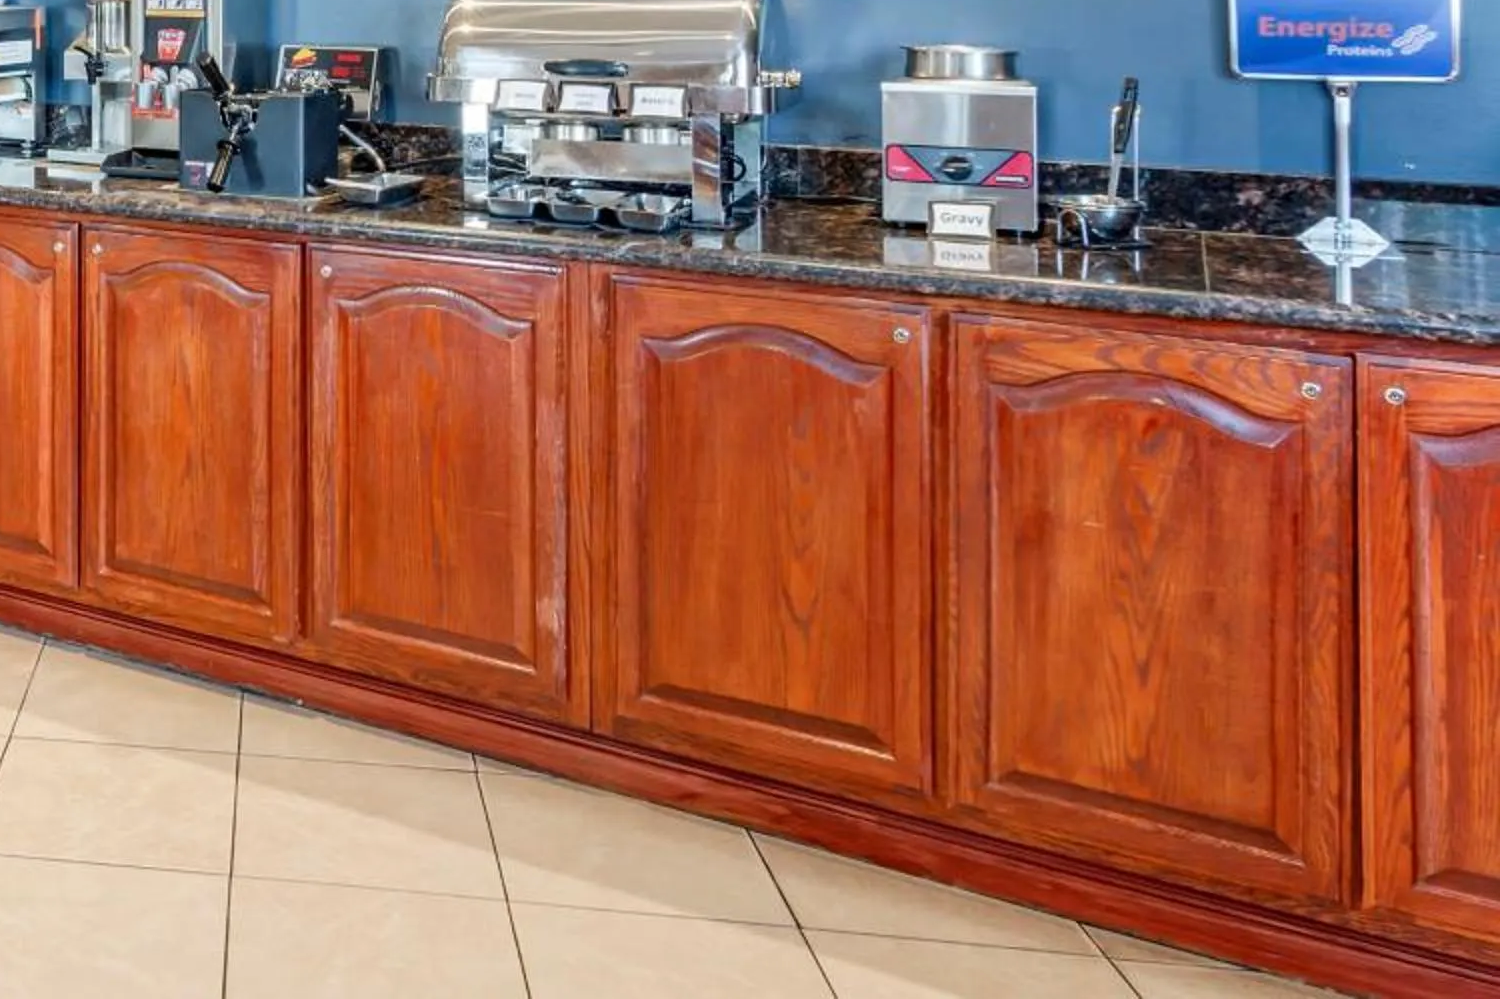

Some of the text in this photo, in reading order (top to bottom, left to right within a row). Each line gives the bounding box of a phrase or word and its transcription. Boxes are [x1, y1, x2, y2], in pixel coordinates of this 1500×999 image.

[1258, 15, 1394, 43] Energize
[1327, 43, 1394, 57] Proteins
[940, 211, 985, 227] Gravy
